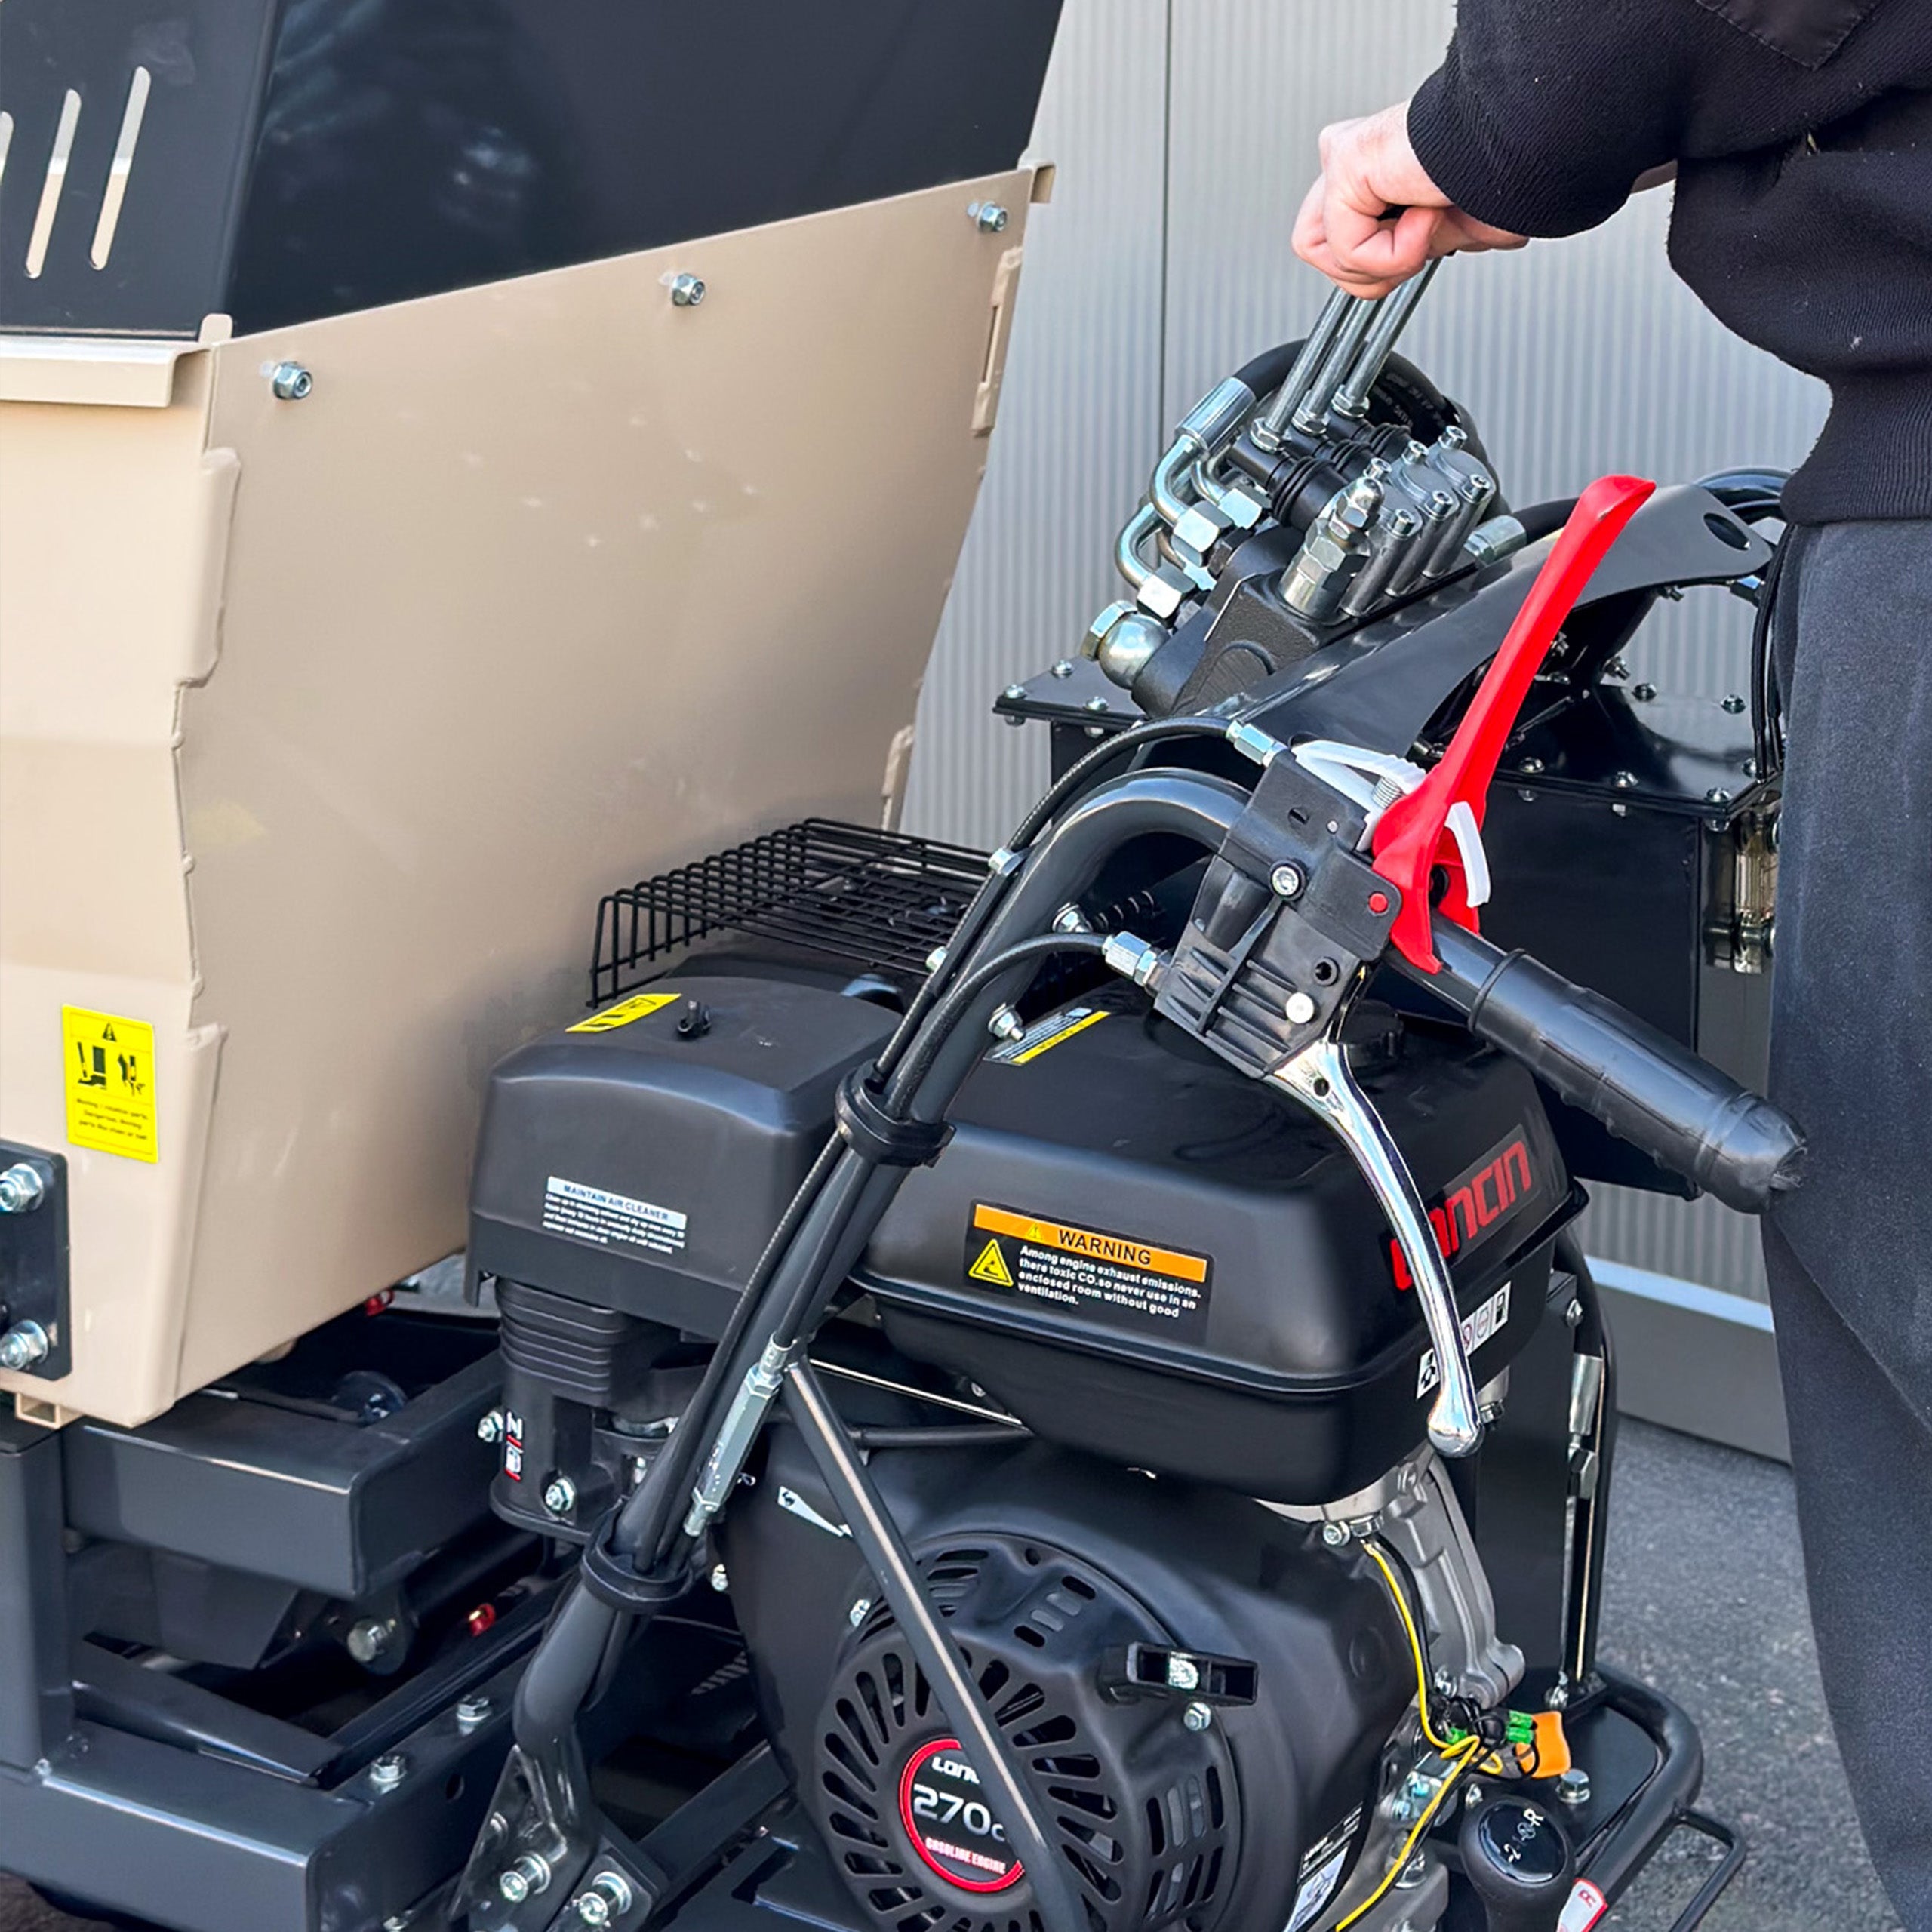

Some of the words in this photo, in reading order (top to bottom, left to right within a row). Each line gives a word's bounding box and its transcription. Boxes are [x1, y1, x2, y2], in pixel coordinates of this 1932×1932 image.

[564, 1185, 606, 1202] MAINTAIN
[608, 1197, 623, 1209] AIR
[625, 1202, 669, 1220] CLEANER
[1059, 1229, 1151, 1265] WARNING
[1019, 1257, 1048, 1272] there
[1049, 1266, 1076, 1280] toxic
[1113, 1282, 1146, 1297] never
[1146, 1291, 1167, 1302] use
[1168, 1294, 1180, 1306] in
[1182, 1299, 1196, 1309] an
[1020, 1245, 1058, 1265] Among
[1060, 1257, 1096, 1272] engine
[1097, 1266, 1140, 1283] exhaust
[1142, 1276, 1201, 1298] emissions.
[1017, 1282, 1079, 1305] ventilation.
[1018, 1271, 1070, 1291] enclosed
[1072, 1284, 1102, 1298] room
[1103, 1292, 1147, 1311] without
[1149, 1303, 1180, 1318] good
[1524, 1808, 1544, 1826] R
[971, 1852, 1006, 1875] ENGINE
